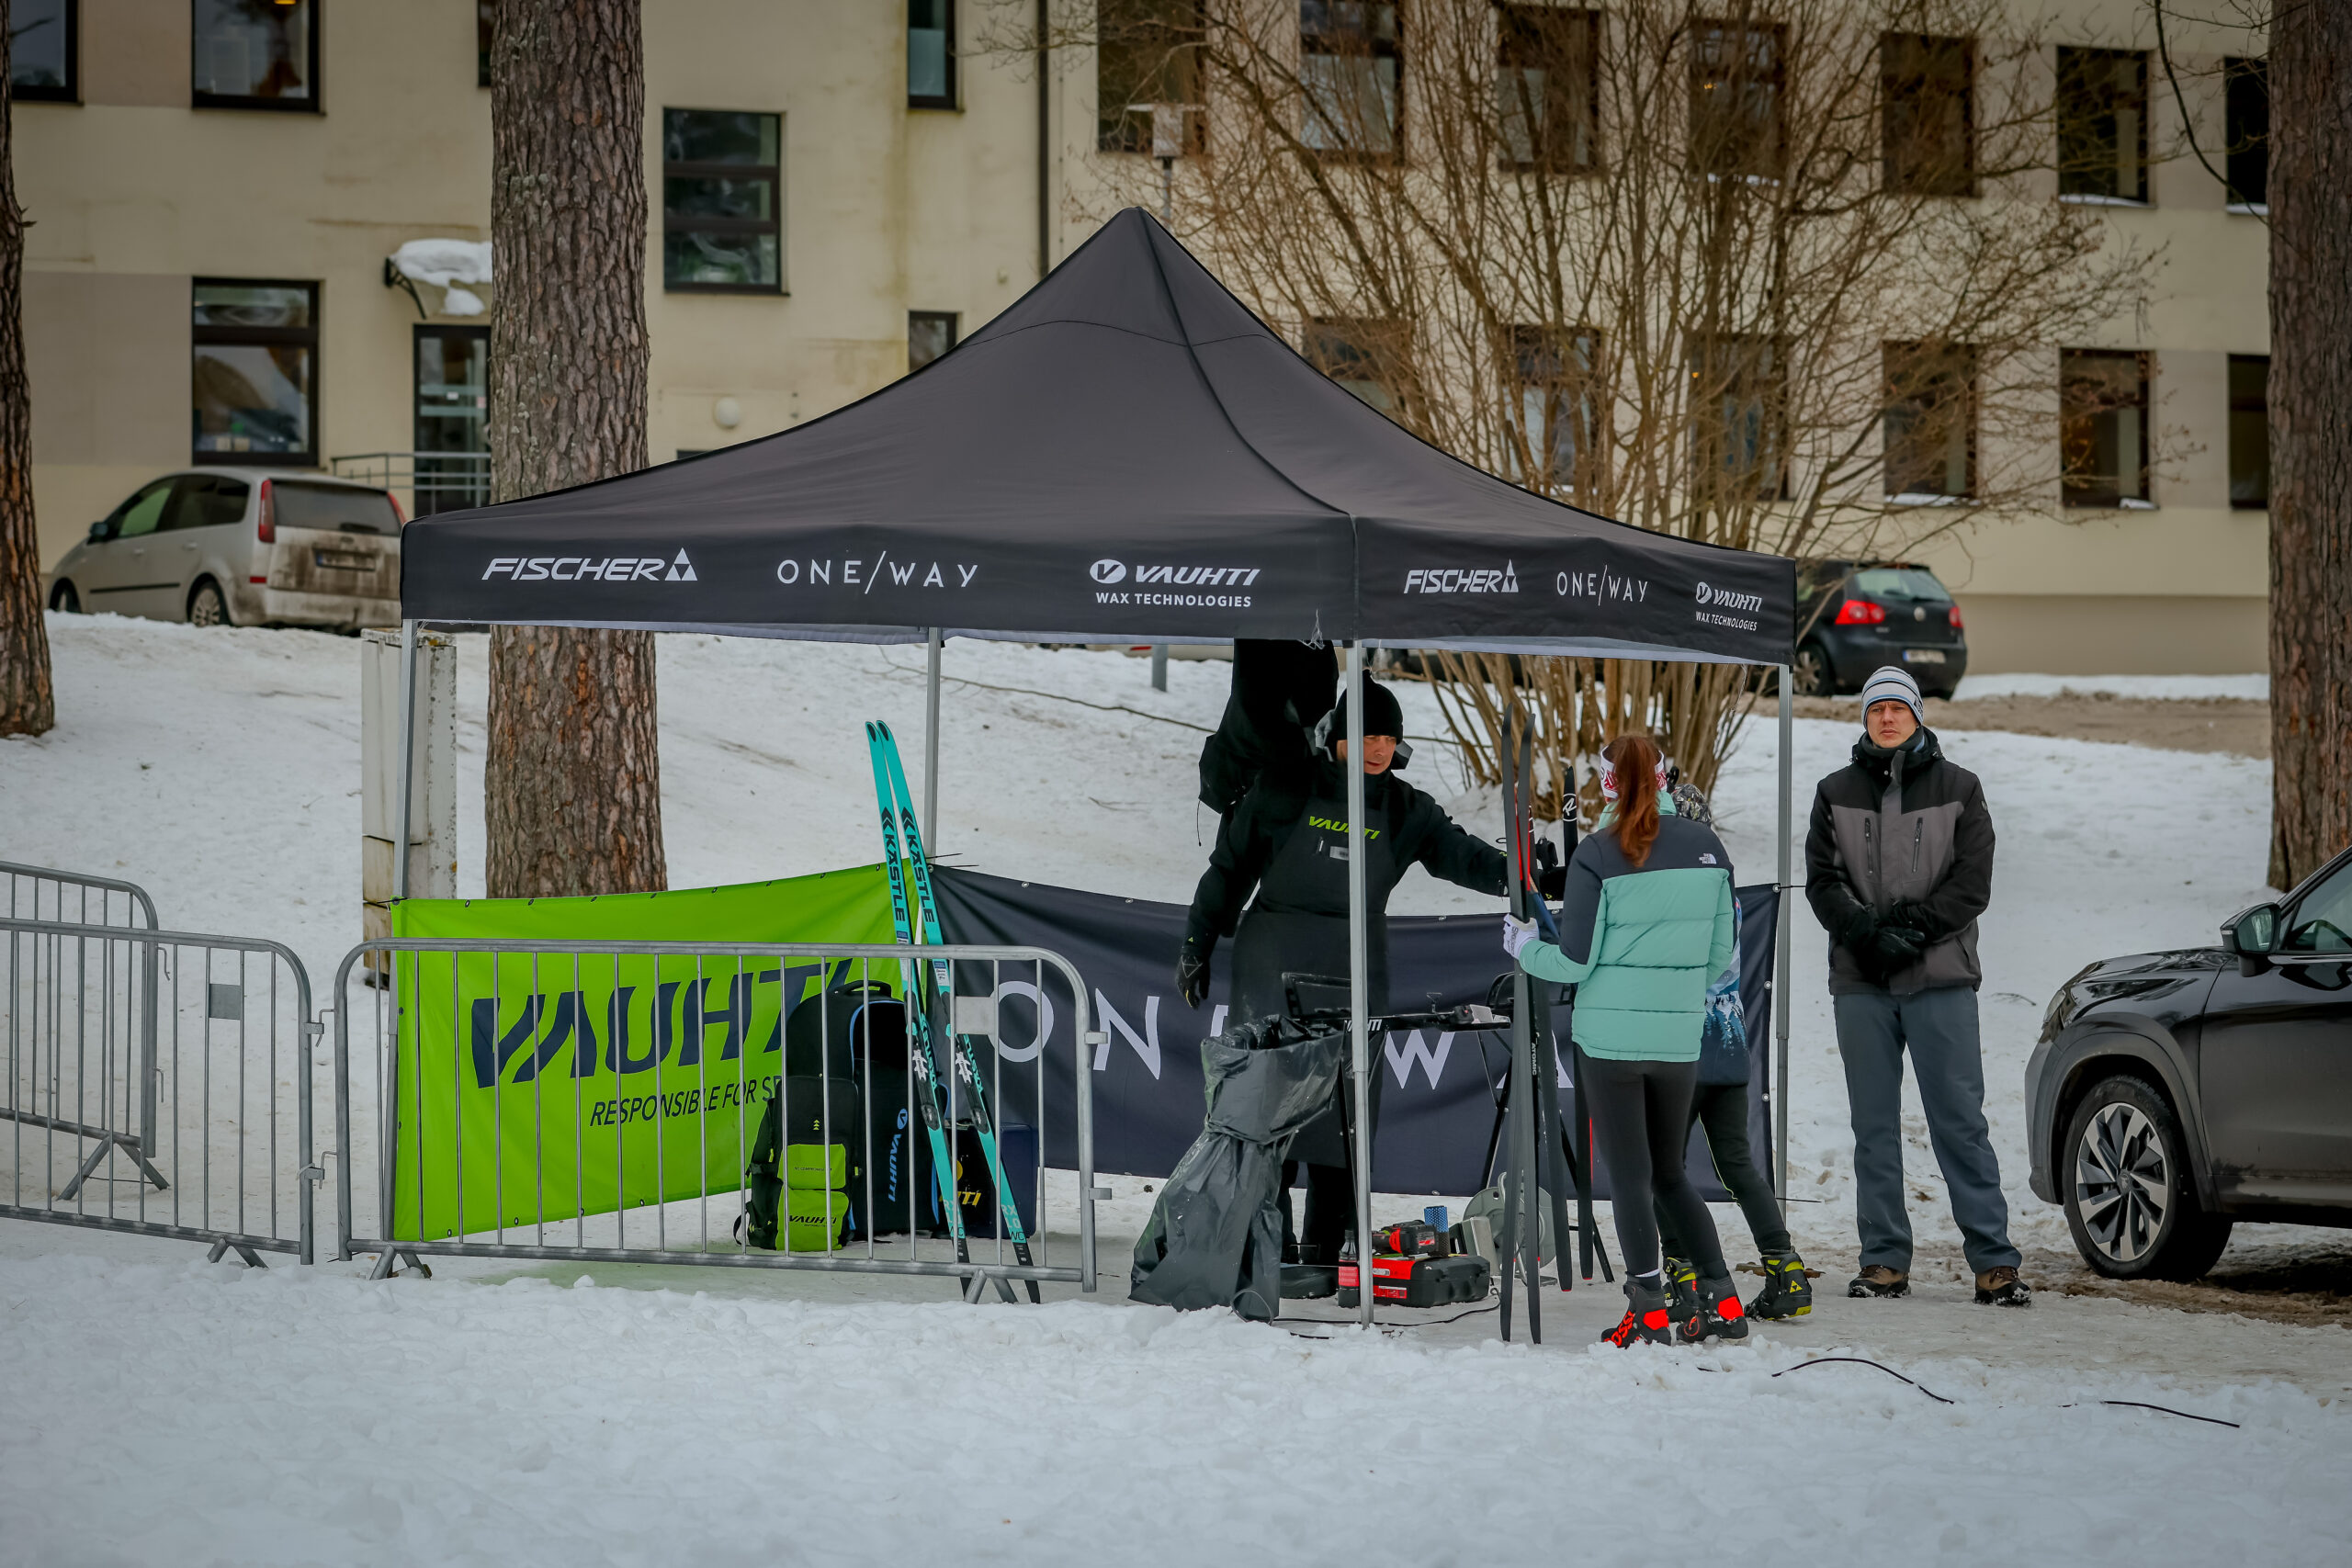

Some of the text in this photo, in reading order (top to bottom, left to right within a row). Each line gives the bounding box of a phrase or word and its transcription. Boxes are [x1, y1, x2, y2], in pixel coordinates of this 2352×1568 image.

[481, 558, 665, 581] FISCHER
[1136, 565, 1261, 586] VAUHTI
[1404, 569, 1503, 594] FISCHER
[1096, 592, 1251, 608] WAX TECHNOLOGIES
[1713, 589, 1762, 613] VAUHTI
[1695, 611, 1758, 632] WAX TECHNOLOGIES
[590, 1086, 718, 1127] RESPONSIBLE
[722, 1079, 757, 1108] FOR
[888, 1134, 901, 1202] VAUHTI
